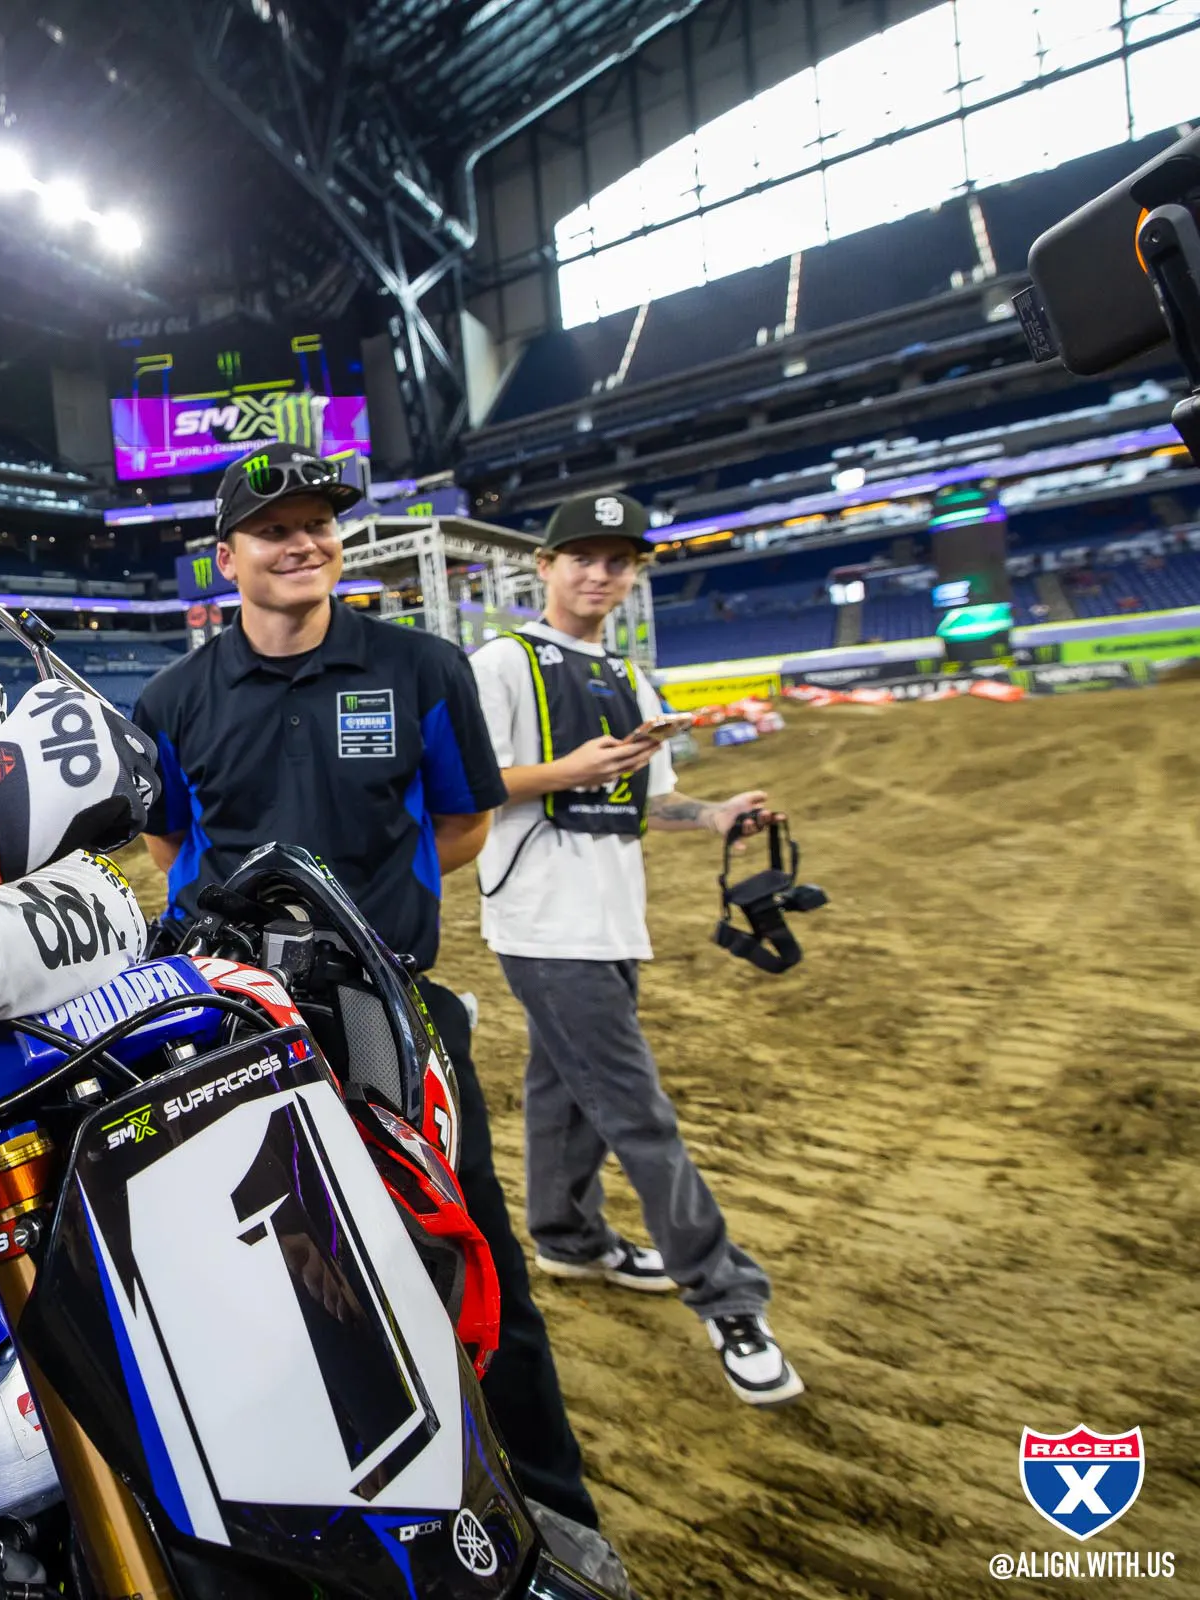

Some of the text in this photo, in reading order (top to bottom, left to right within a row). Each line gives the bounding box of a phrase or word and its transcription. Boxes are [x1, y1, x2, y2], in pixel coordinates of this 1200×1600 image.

[107, 1053, 283, 1150] SMX SUPERCROSS
[231, 1090, 441, 1503] 1
